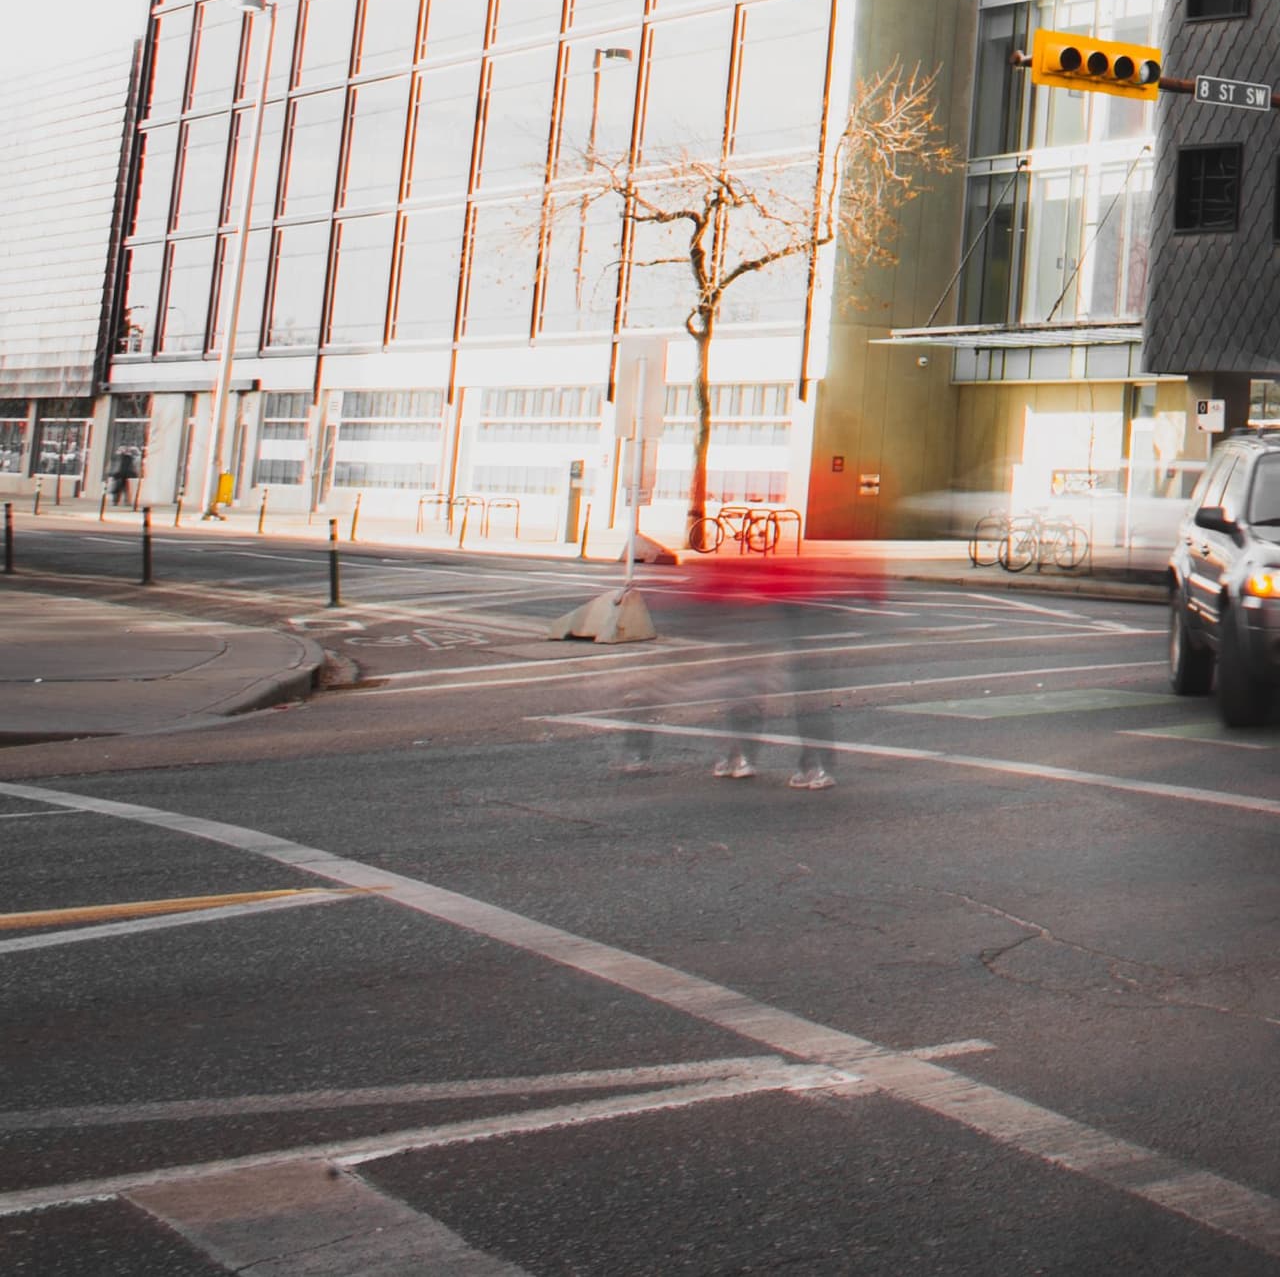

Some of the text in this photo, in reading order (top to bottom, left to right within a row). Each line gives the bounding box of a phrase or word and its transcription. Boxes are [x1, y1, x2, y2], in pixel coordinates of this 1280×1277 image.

[1200, 80, 1266, 106] 8 ST SW
